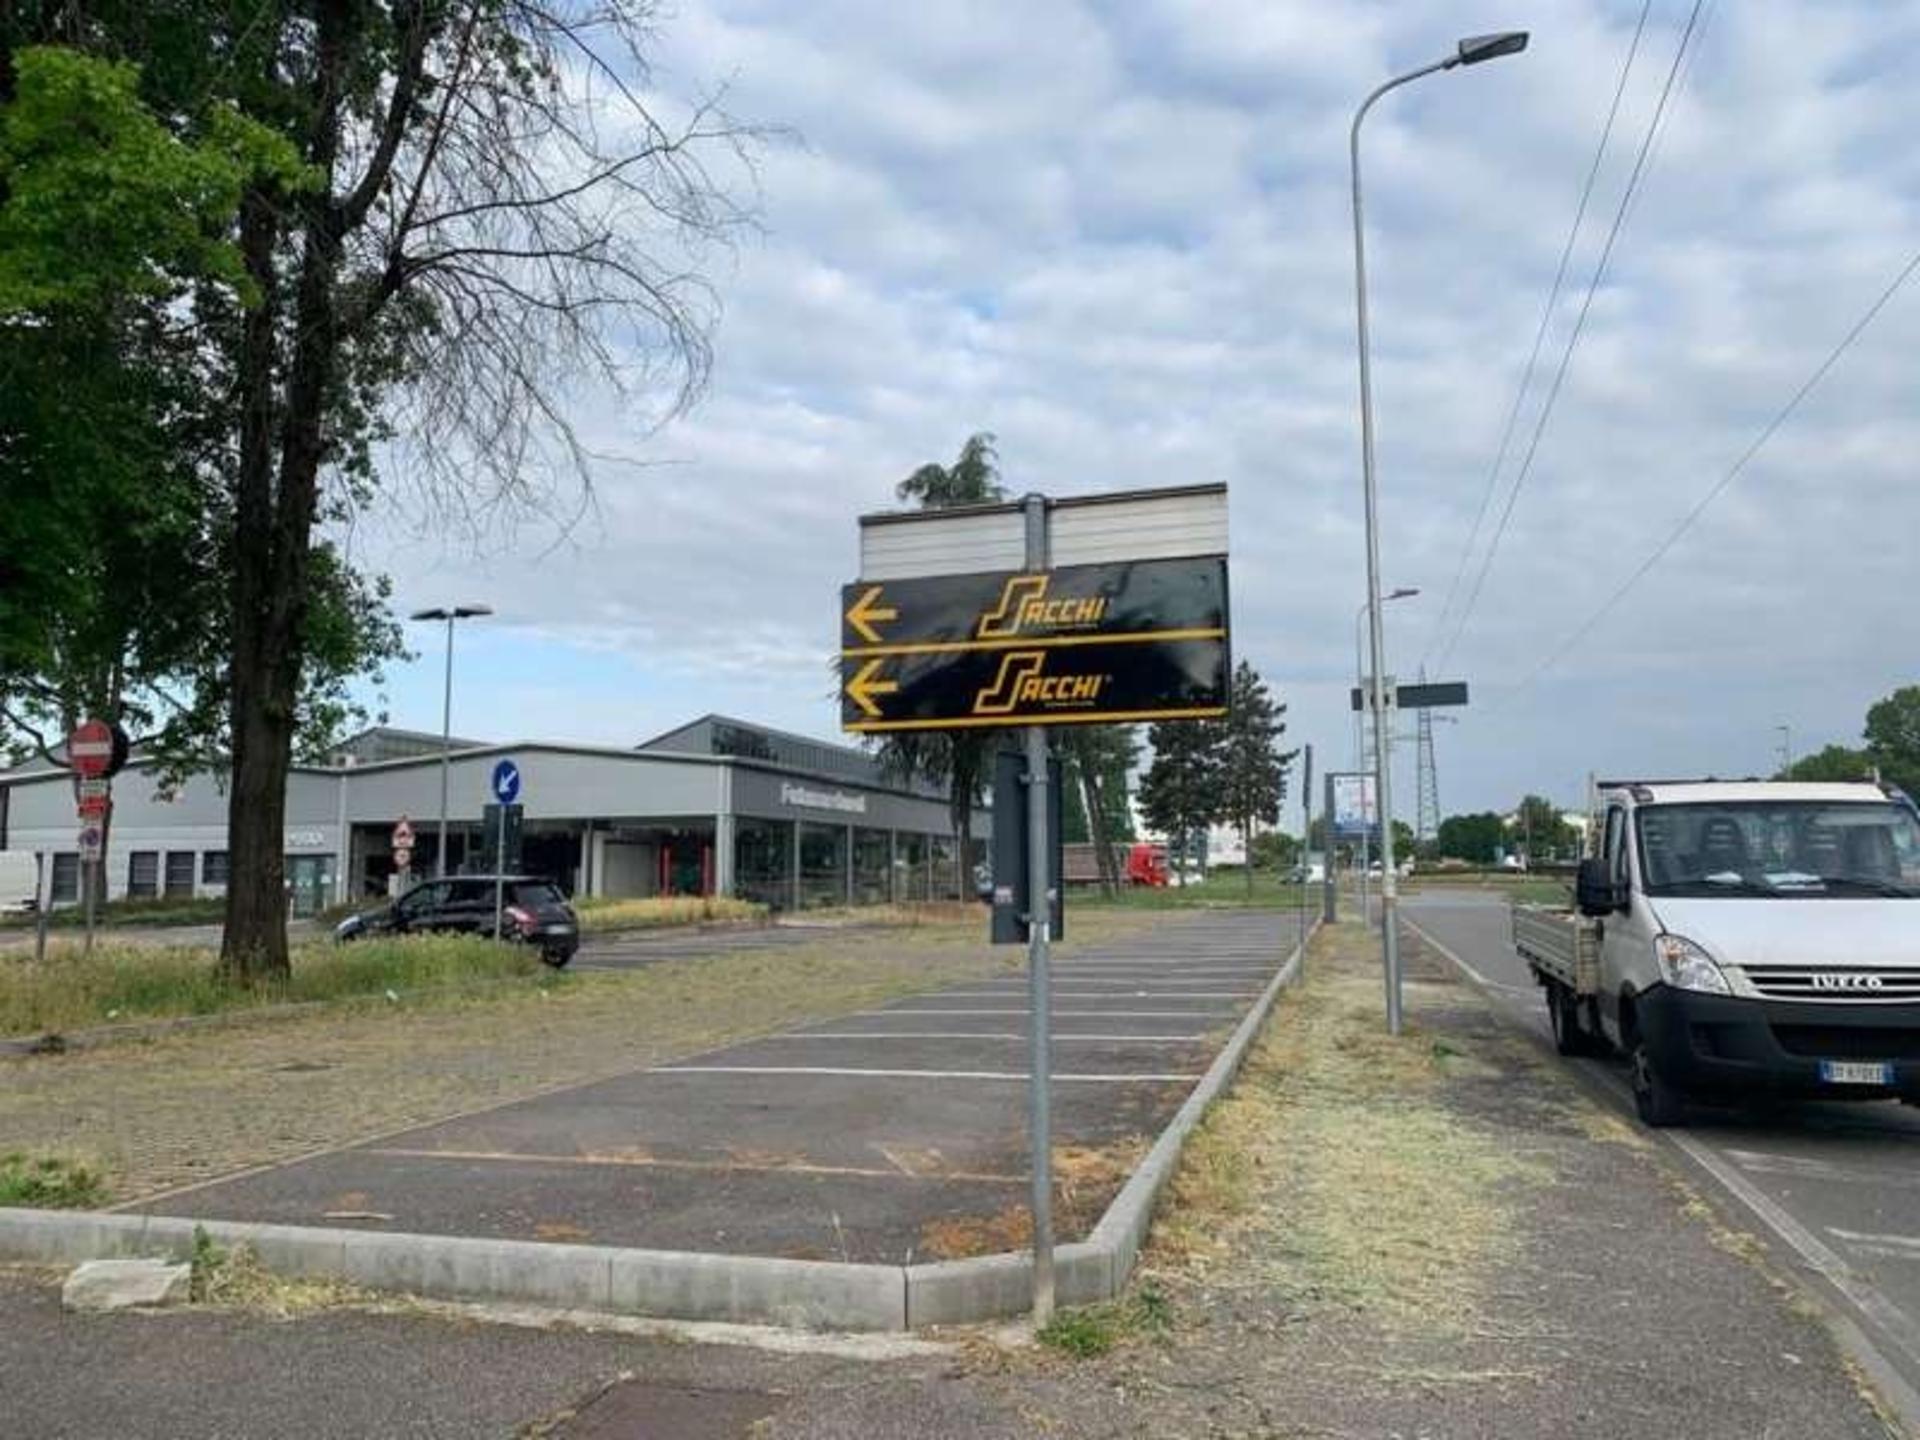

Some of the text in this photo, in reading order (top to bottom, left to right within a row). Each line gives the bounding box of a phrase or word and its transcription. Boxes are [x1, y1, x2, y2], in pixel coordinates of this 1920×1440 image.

[978, 575, 1105, 637] SACCHI
[973, 652, 1103, 713] SACCHI
[1812, 974, 1882, 991] IVECO
